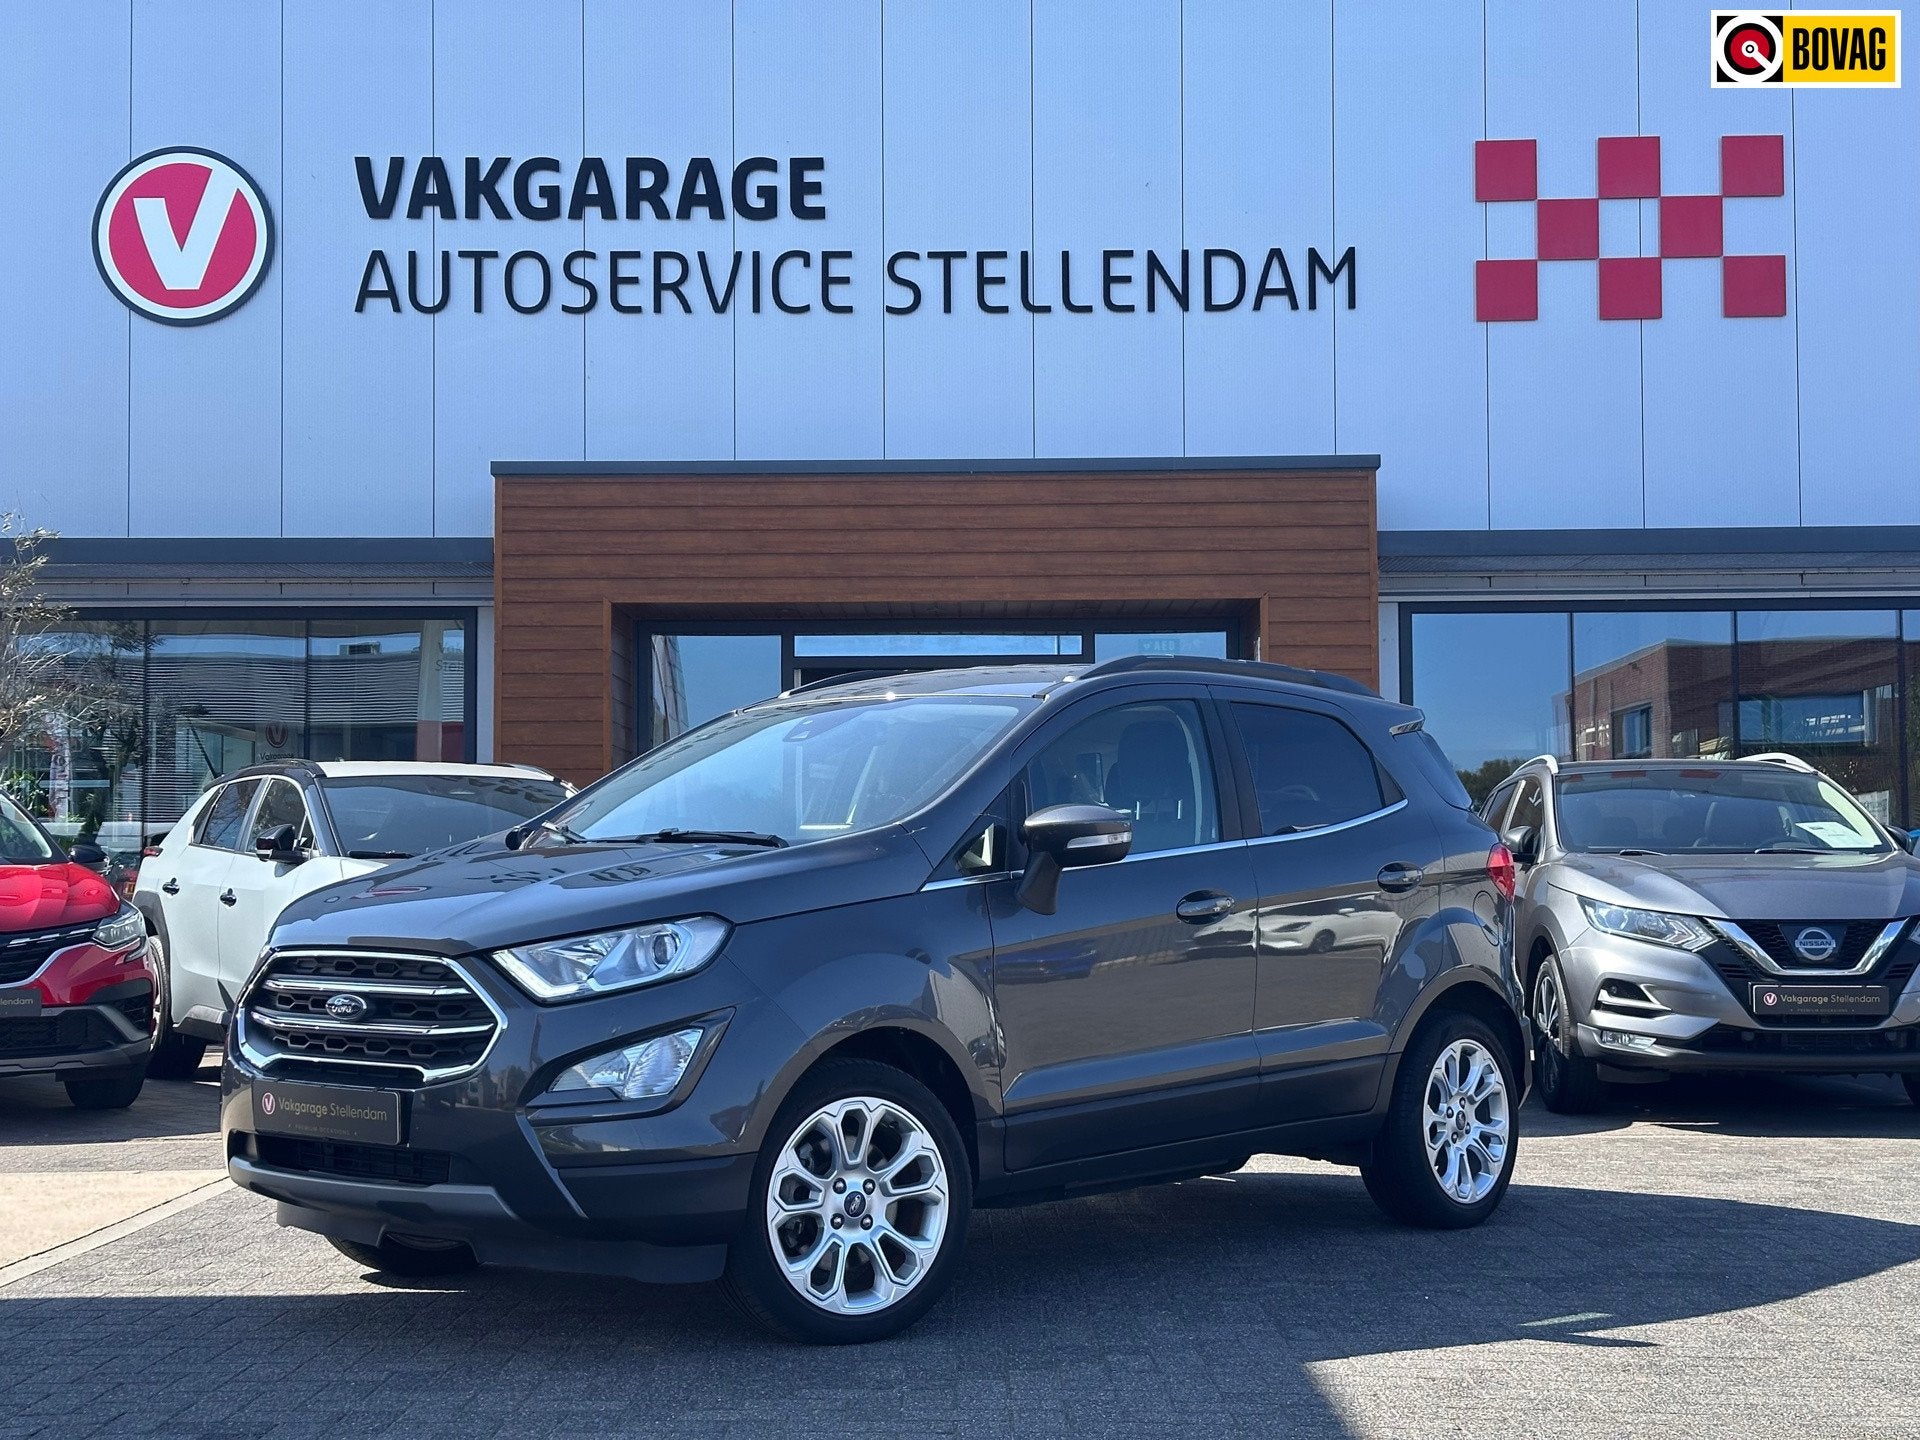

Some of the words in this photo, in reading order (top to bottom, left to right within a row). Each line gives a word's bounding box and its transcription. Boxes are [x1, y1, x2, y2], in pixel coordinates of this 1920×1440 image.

[354, 156, 826, 221] VAKGARAGE
[354, 249, 854, 314] AUTOSERVICE
[886, 246, 1357, 315] STELLENDAM
[1780, 994, 1828, 1004] Vakgarage
[1830, 994, 1880, 1004] Stellendam
[279, 1099, 328, 1117] Vakgarage
[330, 1102, 388, 1121] Stellendam
